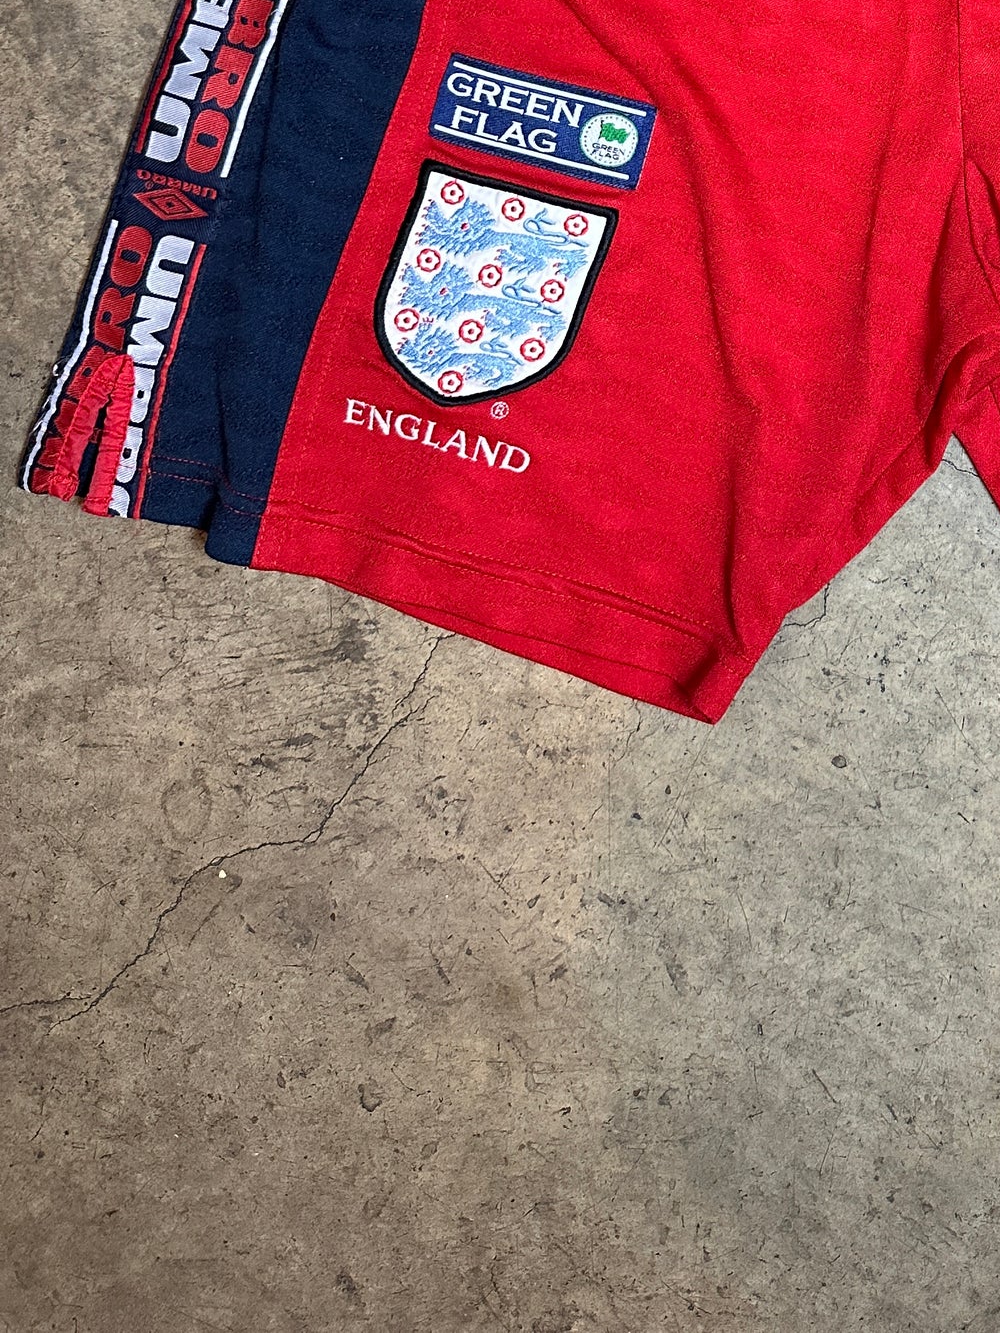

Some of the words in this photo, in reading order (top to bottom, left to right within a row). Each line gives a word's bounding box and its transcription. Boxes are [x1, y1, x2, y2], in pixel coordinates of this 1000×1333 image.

[446, 72, 585, 128] GREEN
[451, 105, 559, 154] FLAG
[343, 397, 532, 474] ENGLAND
